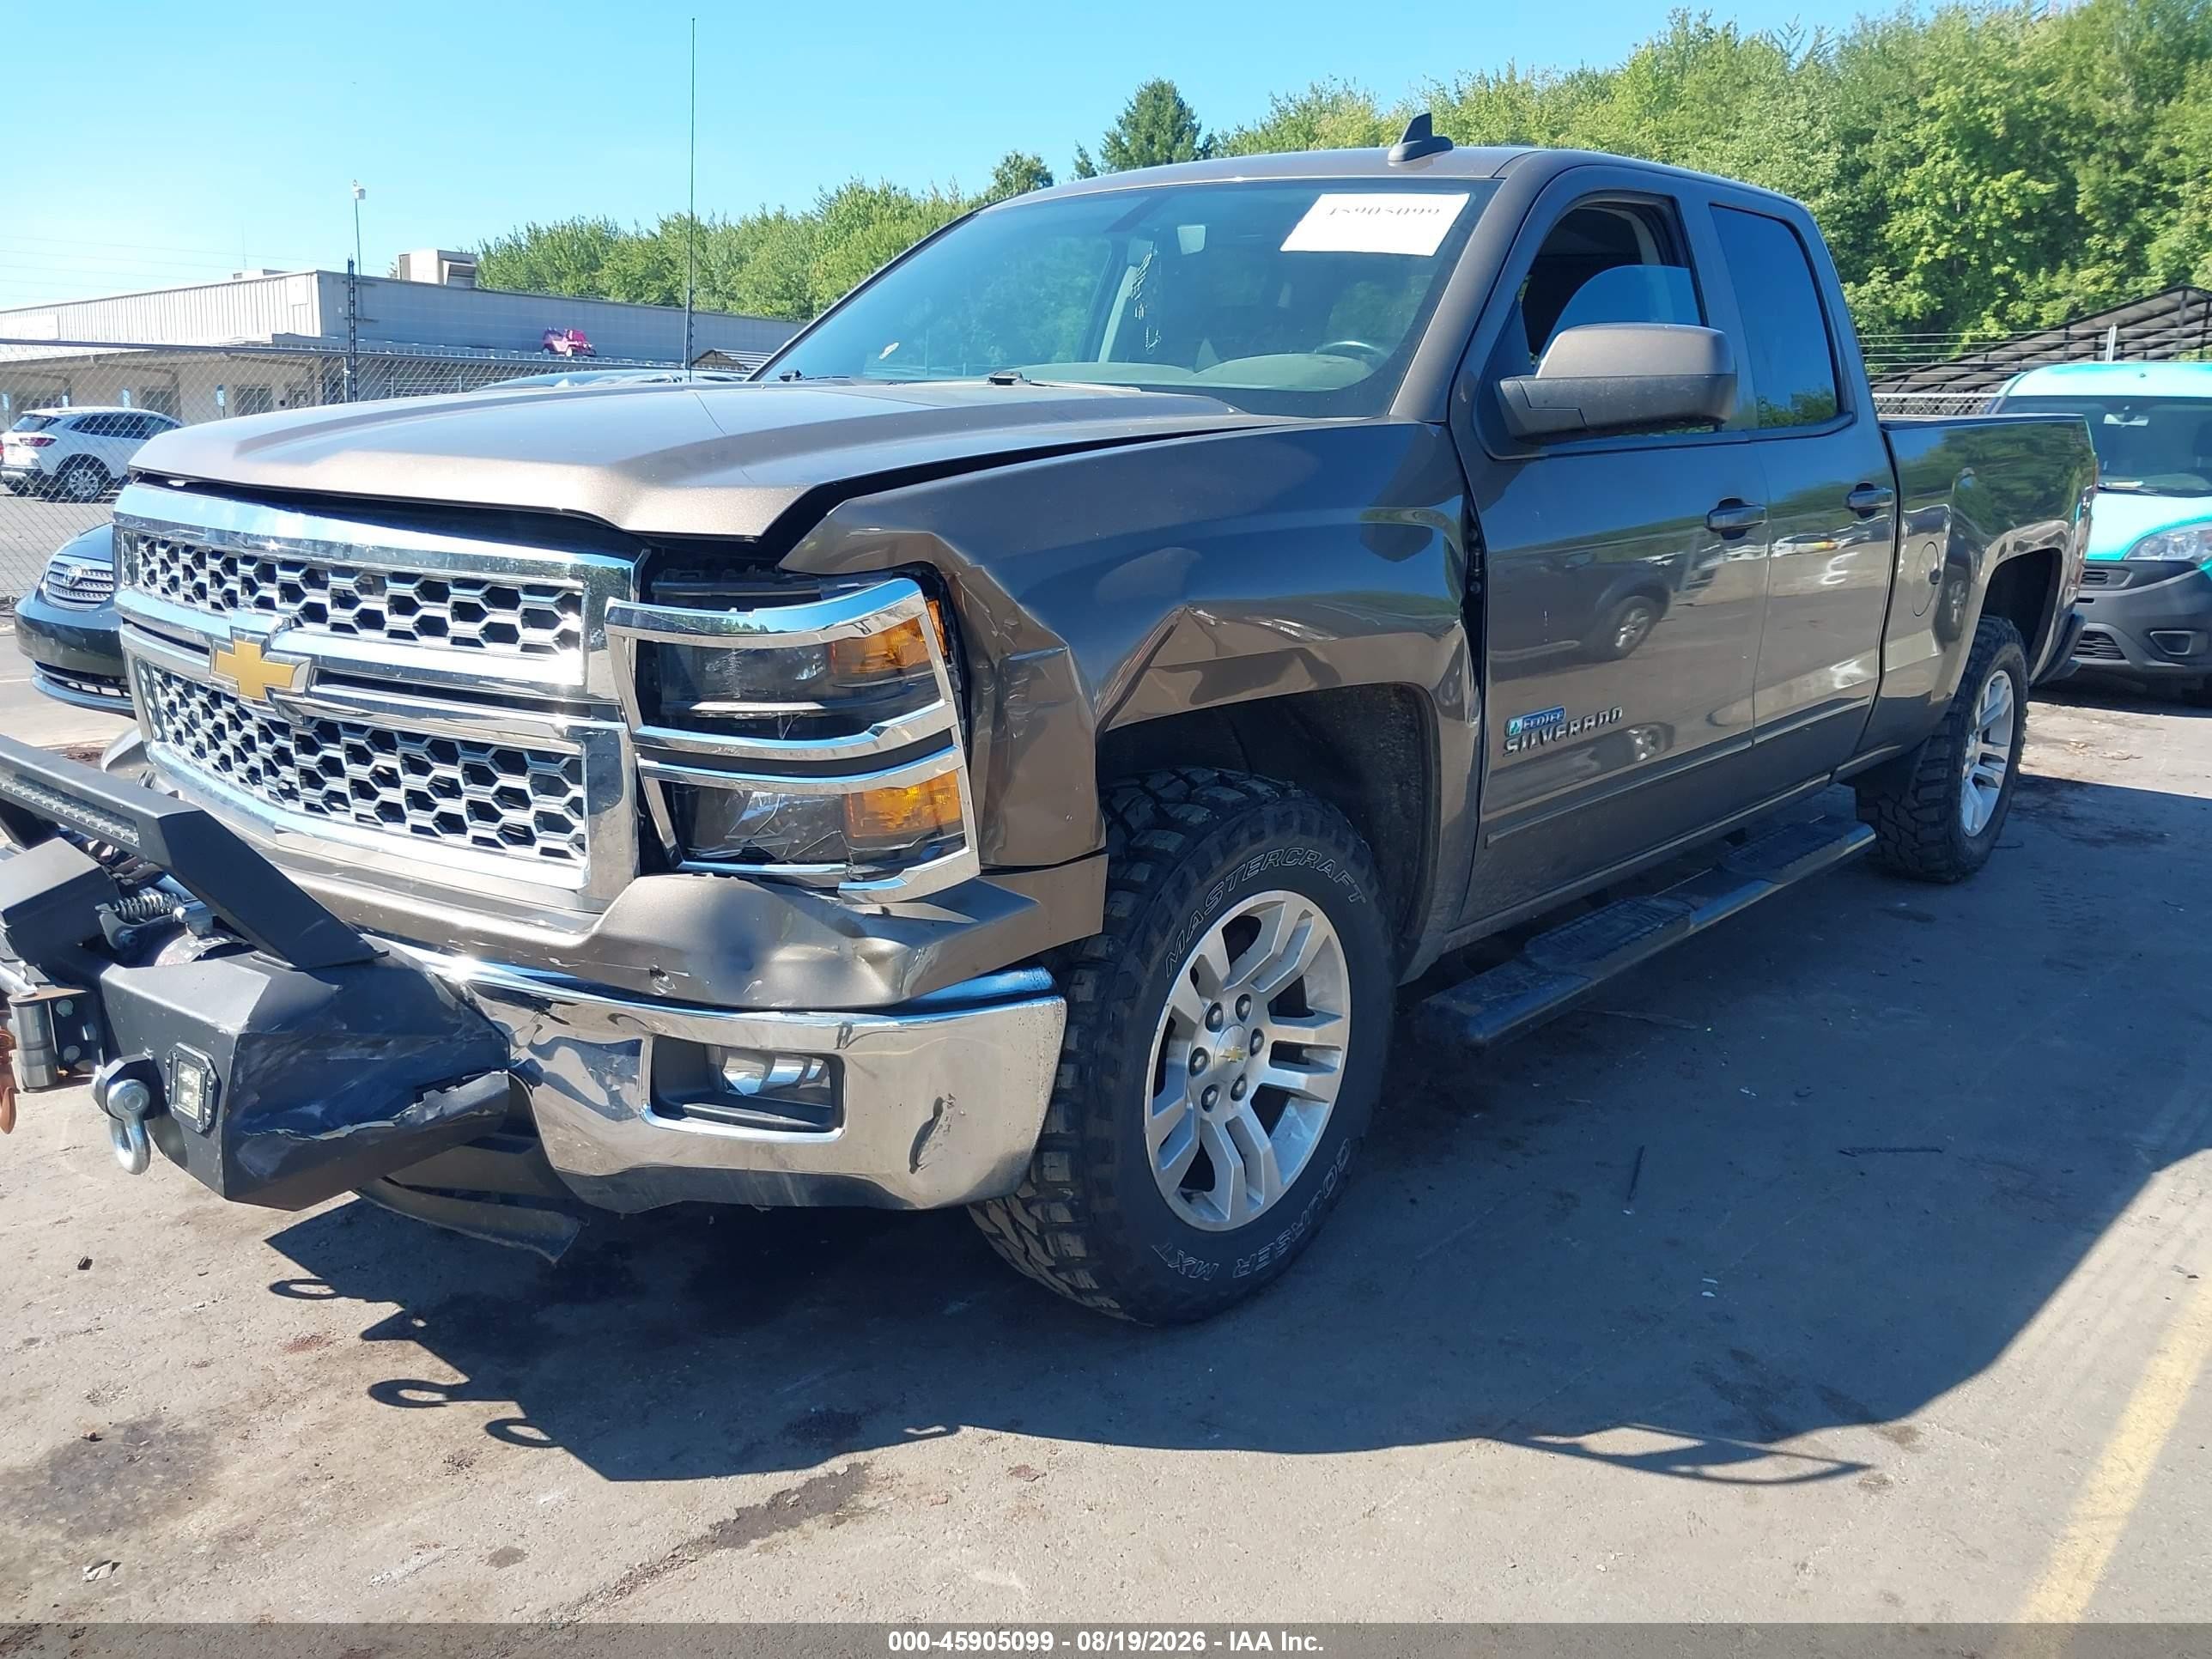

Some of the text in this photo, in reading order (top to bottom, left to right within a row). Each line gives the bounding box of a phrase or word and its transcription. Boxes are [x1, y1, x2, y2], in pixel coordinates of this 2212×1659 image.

[1504, 706, 1624, 757] SILVERADO
[1164, 847, 1367, 978] MASTERCRAFT
[1152, 1138, 1352, 1281] COURSER MXT
